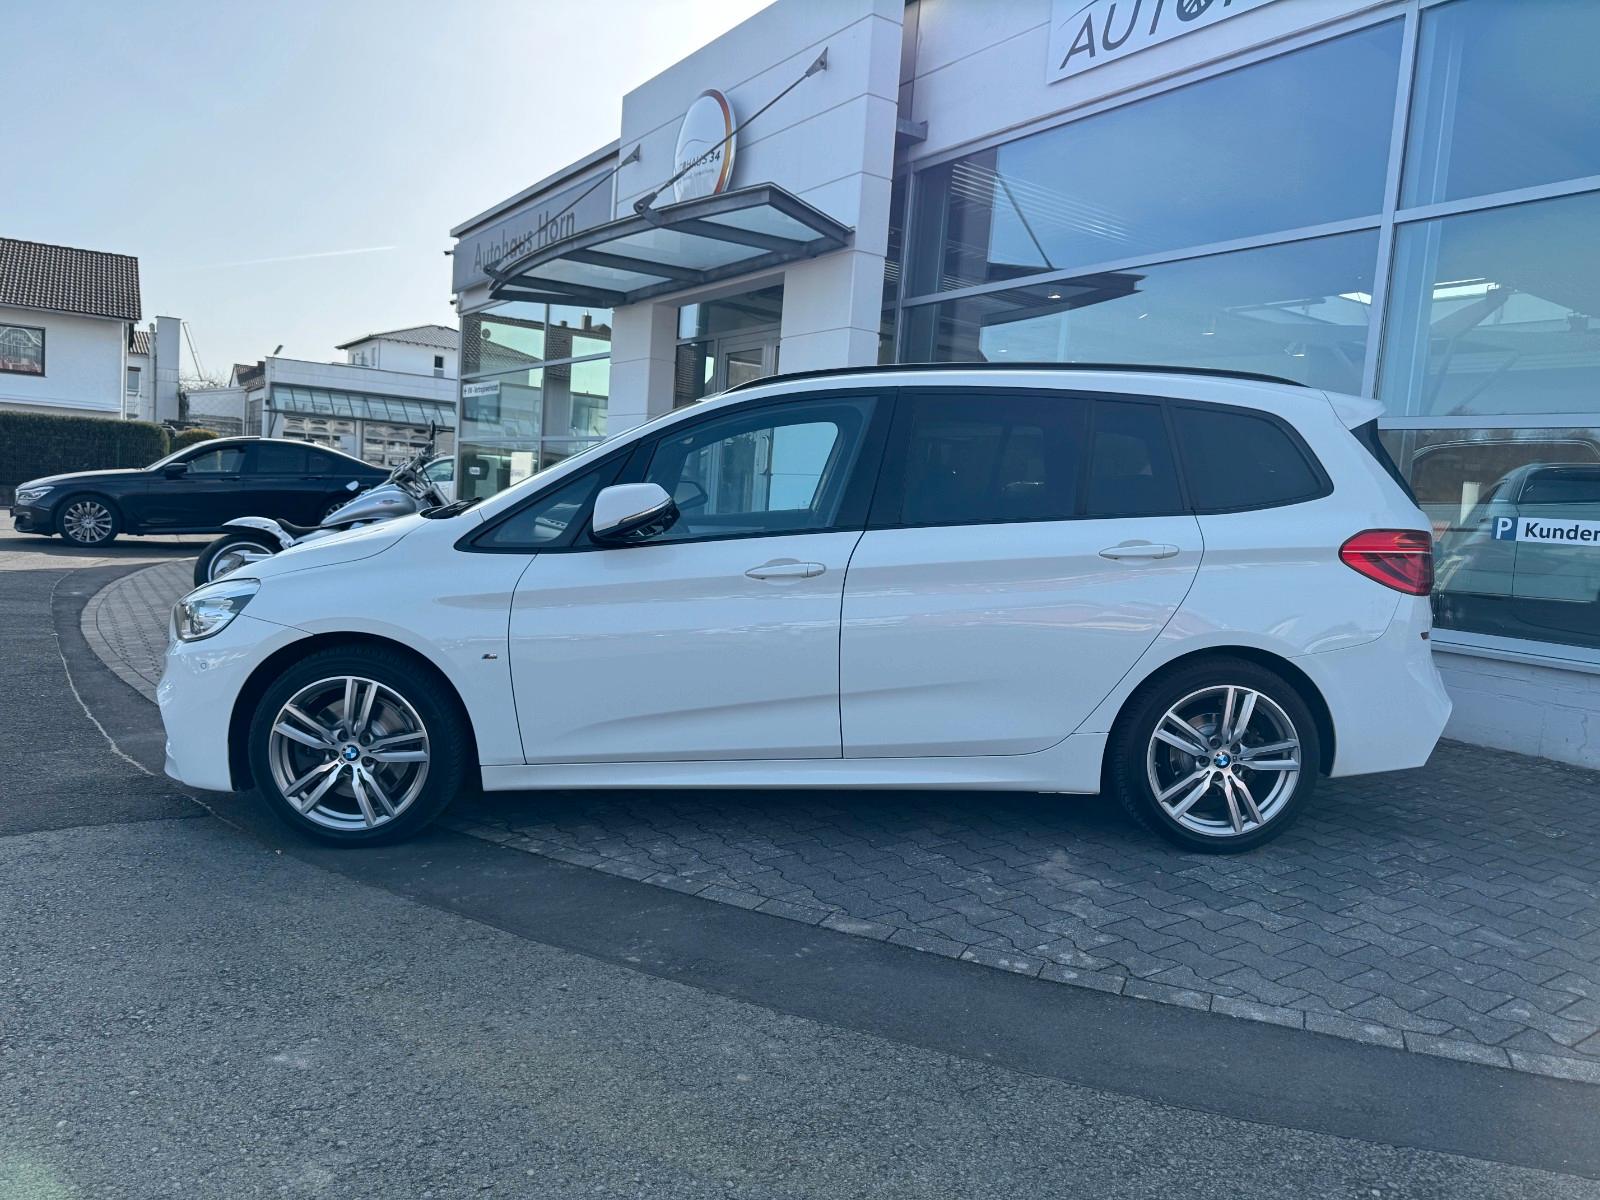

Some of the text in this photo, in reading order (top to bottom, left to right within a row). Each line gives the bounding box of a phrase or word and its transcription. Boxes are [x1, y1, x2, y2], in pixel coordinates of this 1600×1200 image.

[1059, 0, 1232, 70] AUT
[709, 150, 721, 163] 34
[473, 210, 576, 273] Autohaus Horn
[1496, 517, 1513, 540] P
